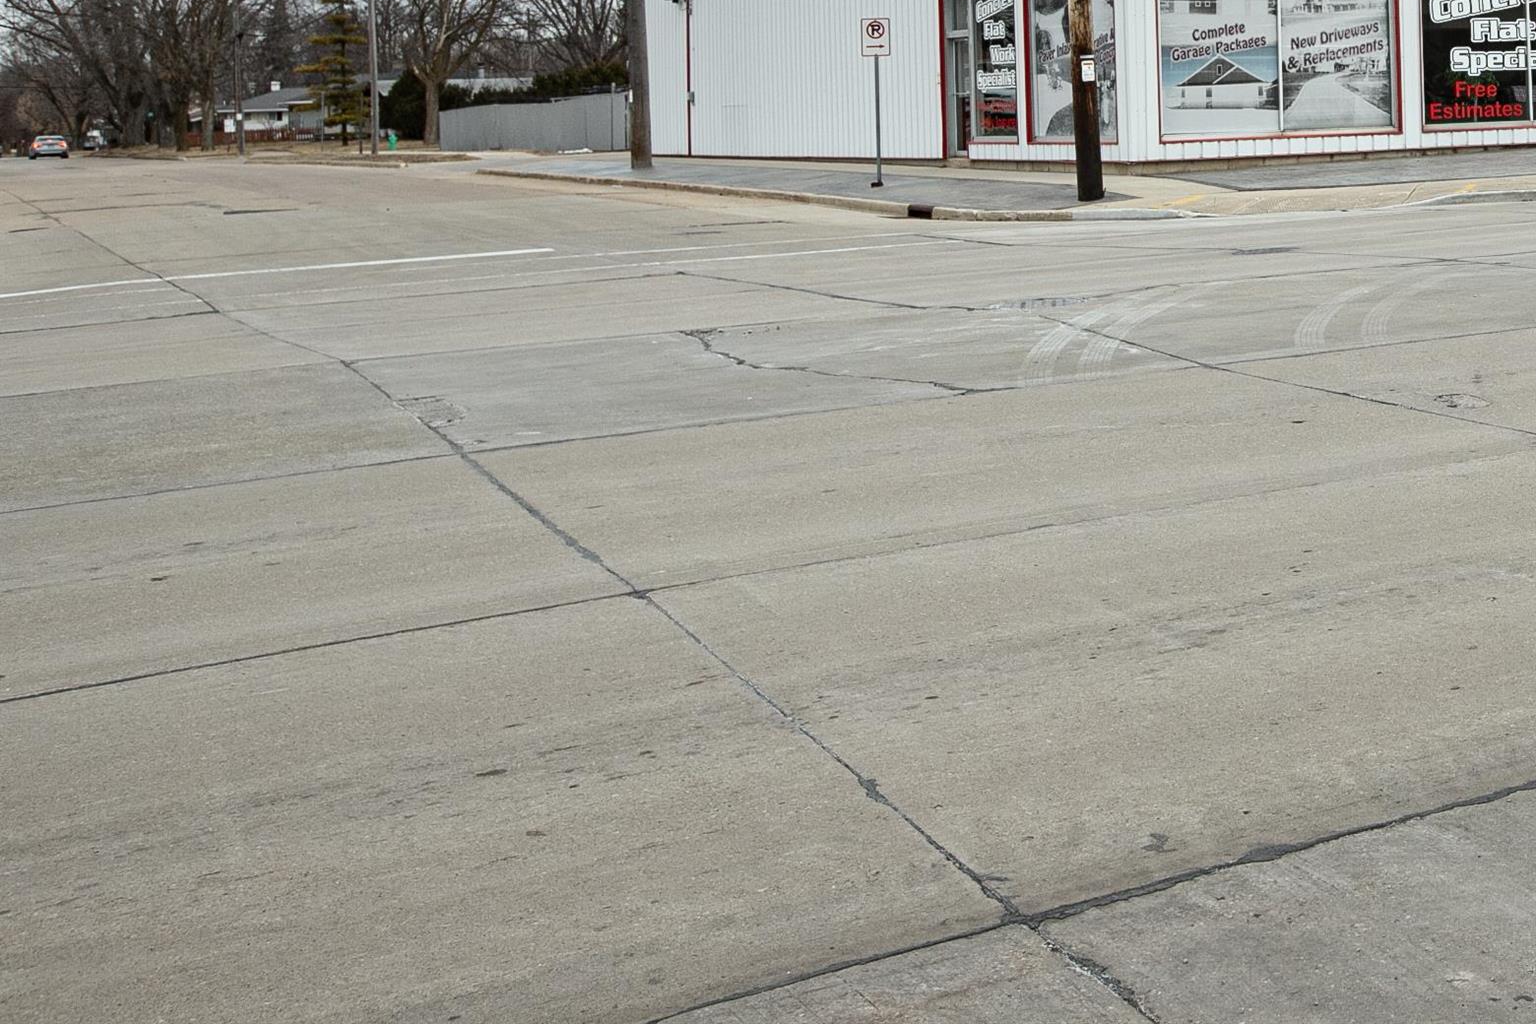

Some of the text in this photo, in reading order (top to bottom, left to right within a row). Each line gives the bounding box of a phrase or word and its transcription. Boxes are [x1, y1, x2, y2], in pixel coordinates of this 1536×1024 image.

[983, 20, 1006, 40] Flat
[1191, 22, 1246, 42] Complete
[1290, 22, 1380, 51] New Driveways
[1470, 17, 1536, 43] Flat
[1171, 35, 1267, 62] Garage Packages
[1286, 39, 1384, 71] & Replacements
[976, 68, 1017, 93] Specialist
[1455, 80, 1498, 98] Free
[1429, 100, 1524, 120] Estimates
